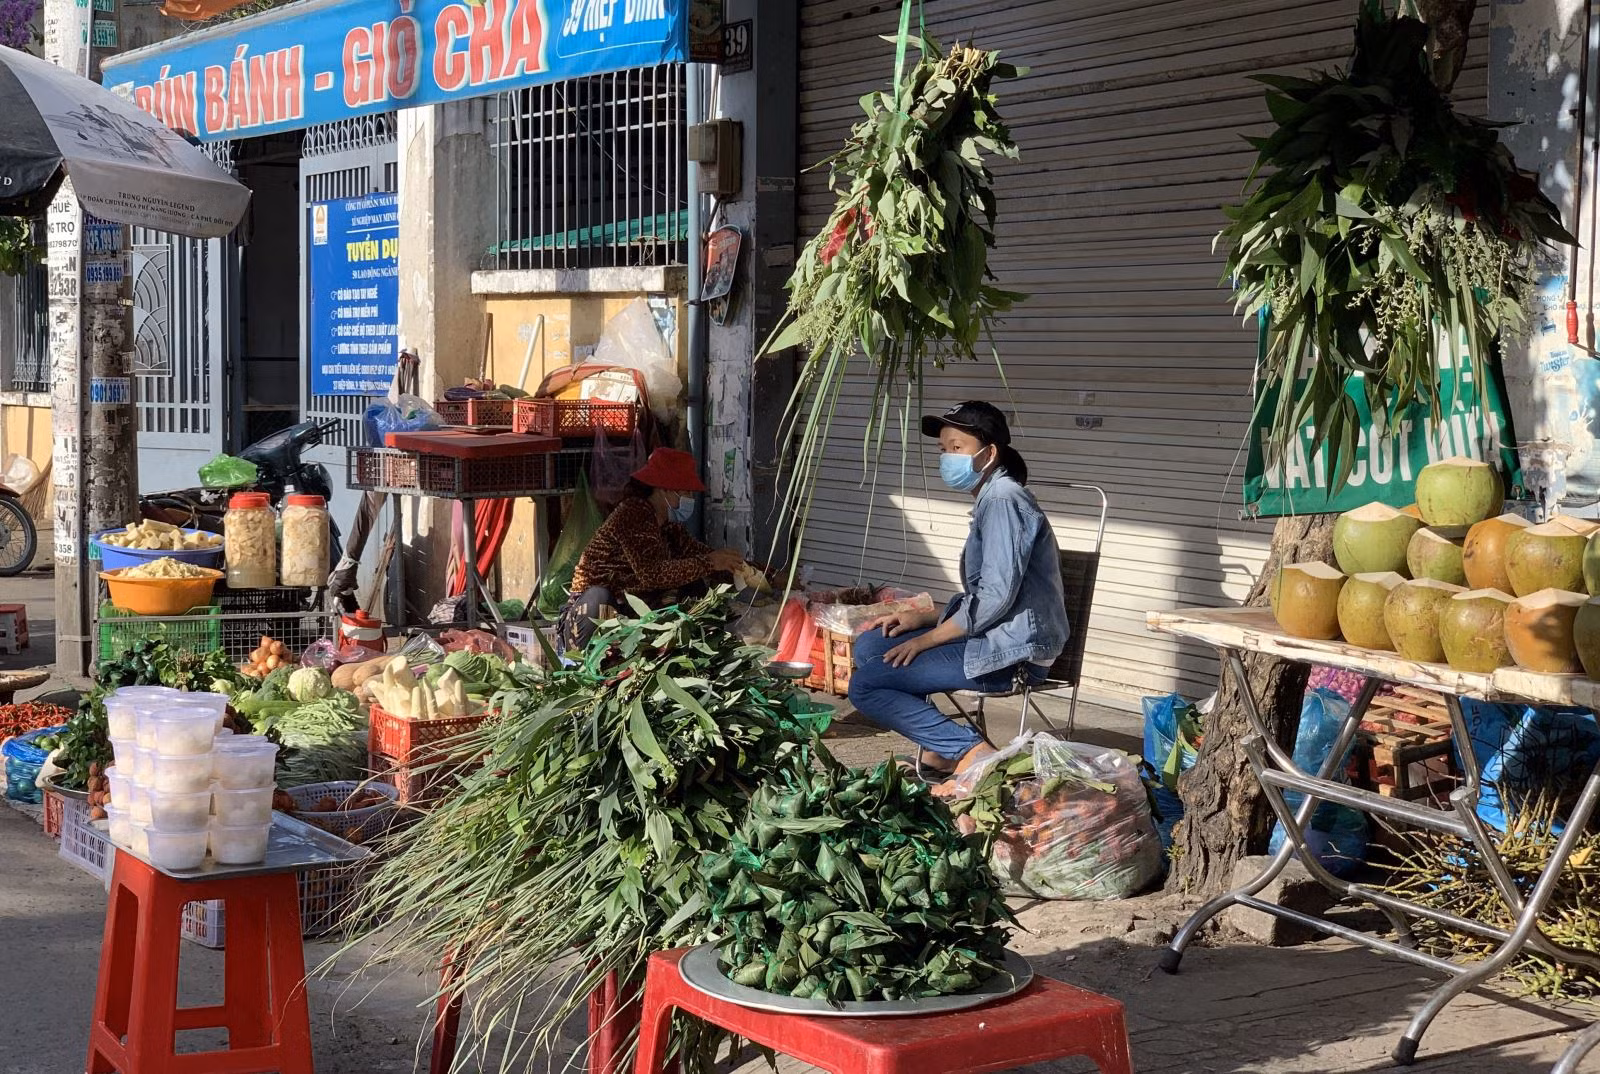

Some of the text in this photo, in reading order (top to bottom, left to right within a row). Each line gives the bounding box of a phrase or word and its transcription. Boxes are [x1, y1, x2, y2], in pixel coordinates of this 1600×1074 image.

[725, 25, 748, 57] 39
[204, 43, 304, 134] BÁNH
[118, 192, 140, 202] TRUNG
[170, 201, 195, 212] LEGEND
[56, 221, 75, 235] TRỌ
[346, 233, 379, 262] TUYỂN
